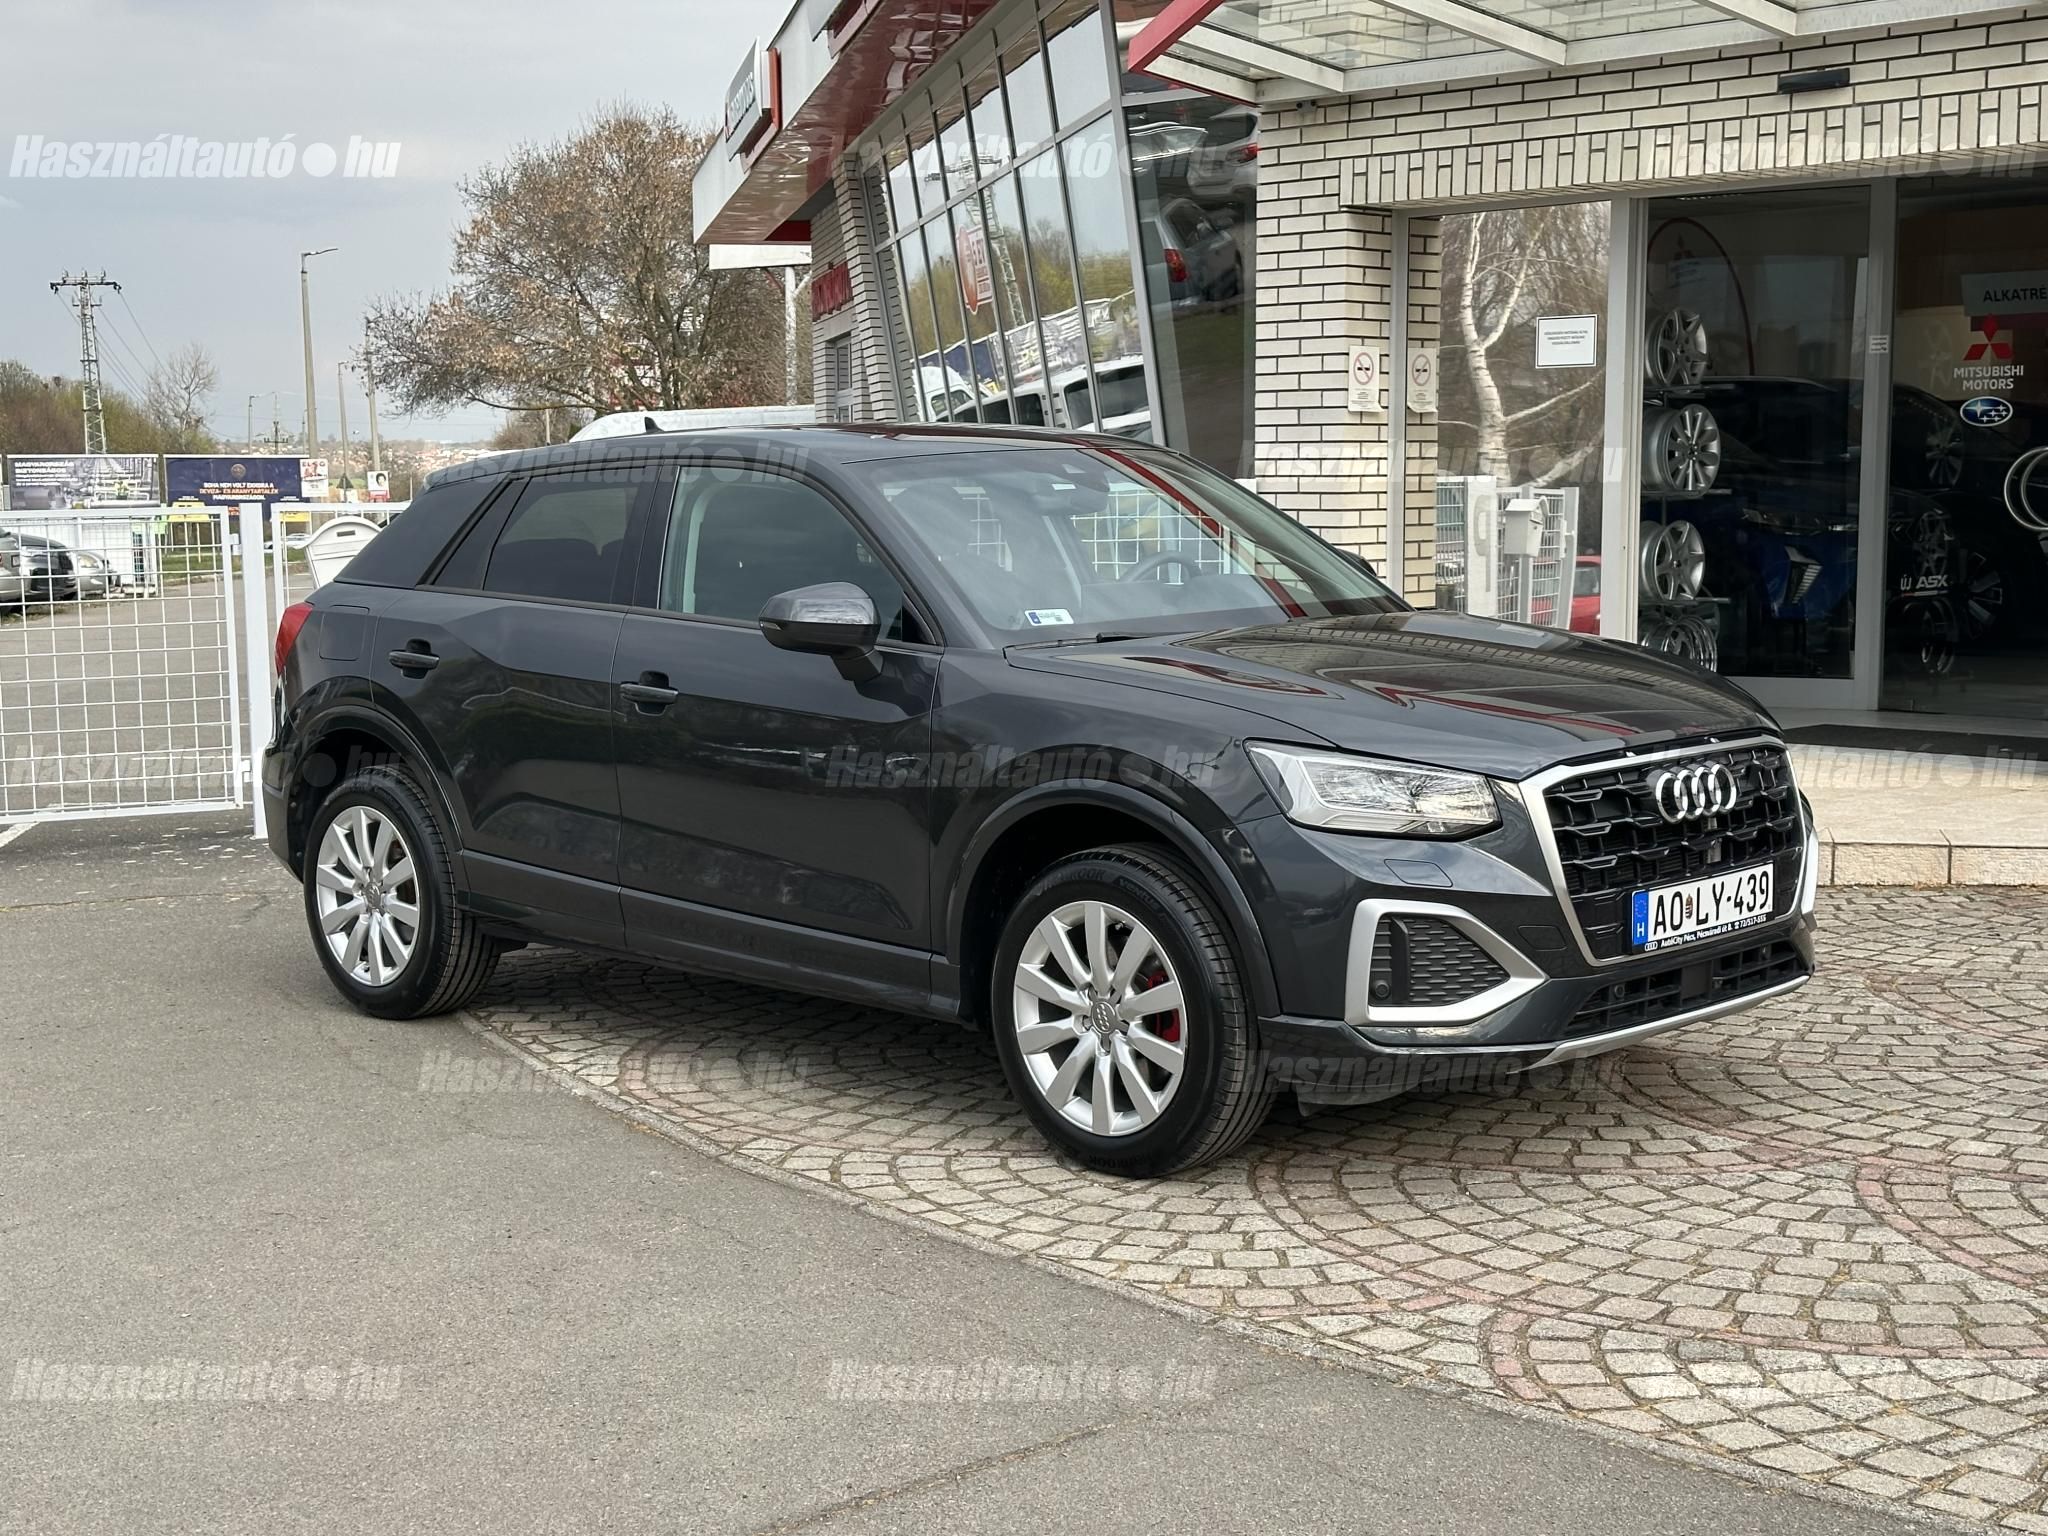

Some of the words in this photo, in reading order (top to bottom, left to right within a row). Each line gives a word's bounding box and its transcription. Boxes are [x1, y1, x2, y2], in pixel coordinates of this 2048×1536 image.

[1983, 284, 2048, 302] ALKATRÉ
[1953, 365, 2024, 379] MITSUBISHI
[1962, 378, 2014, 392] MOTORS
[1915, 574, 1949, 589] ASX
[1637, 922, 1645, 938] H
